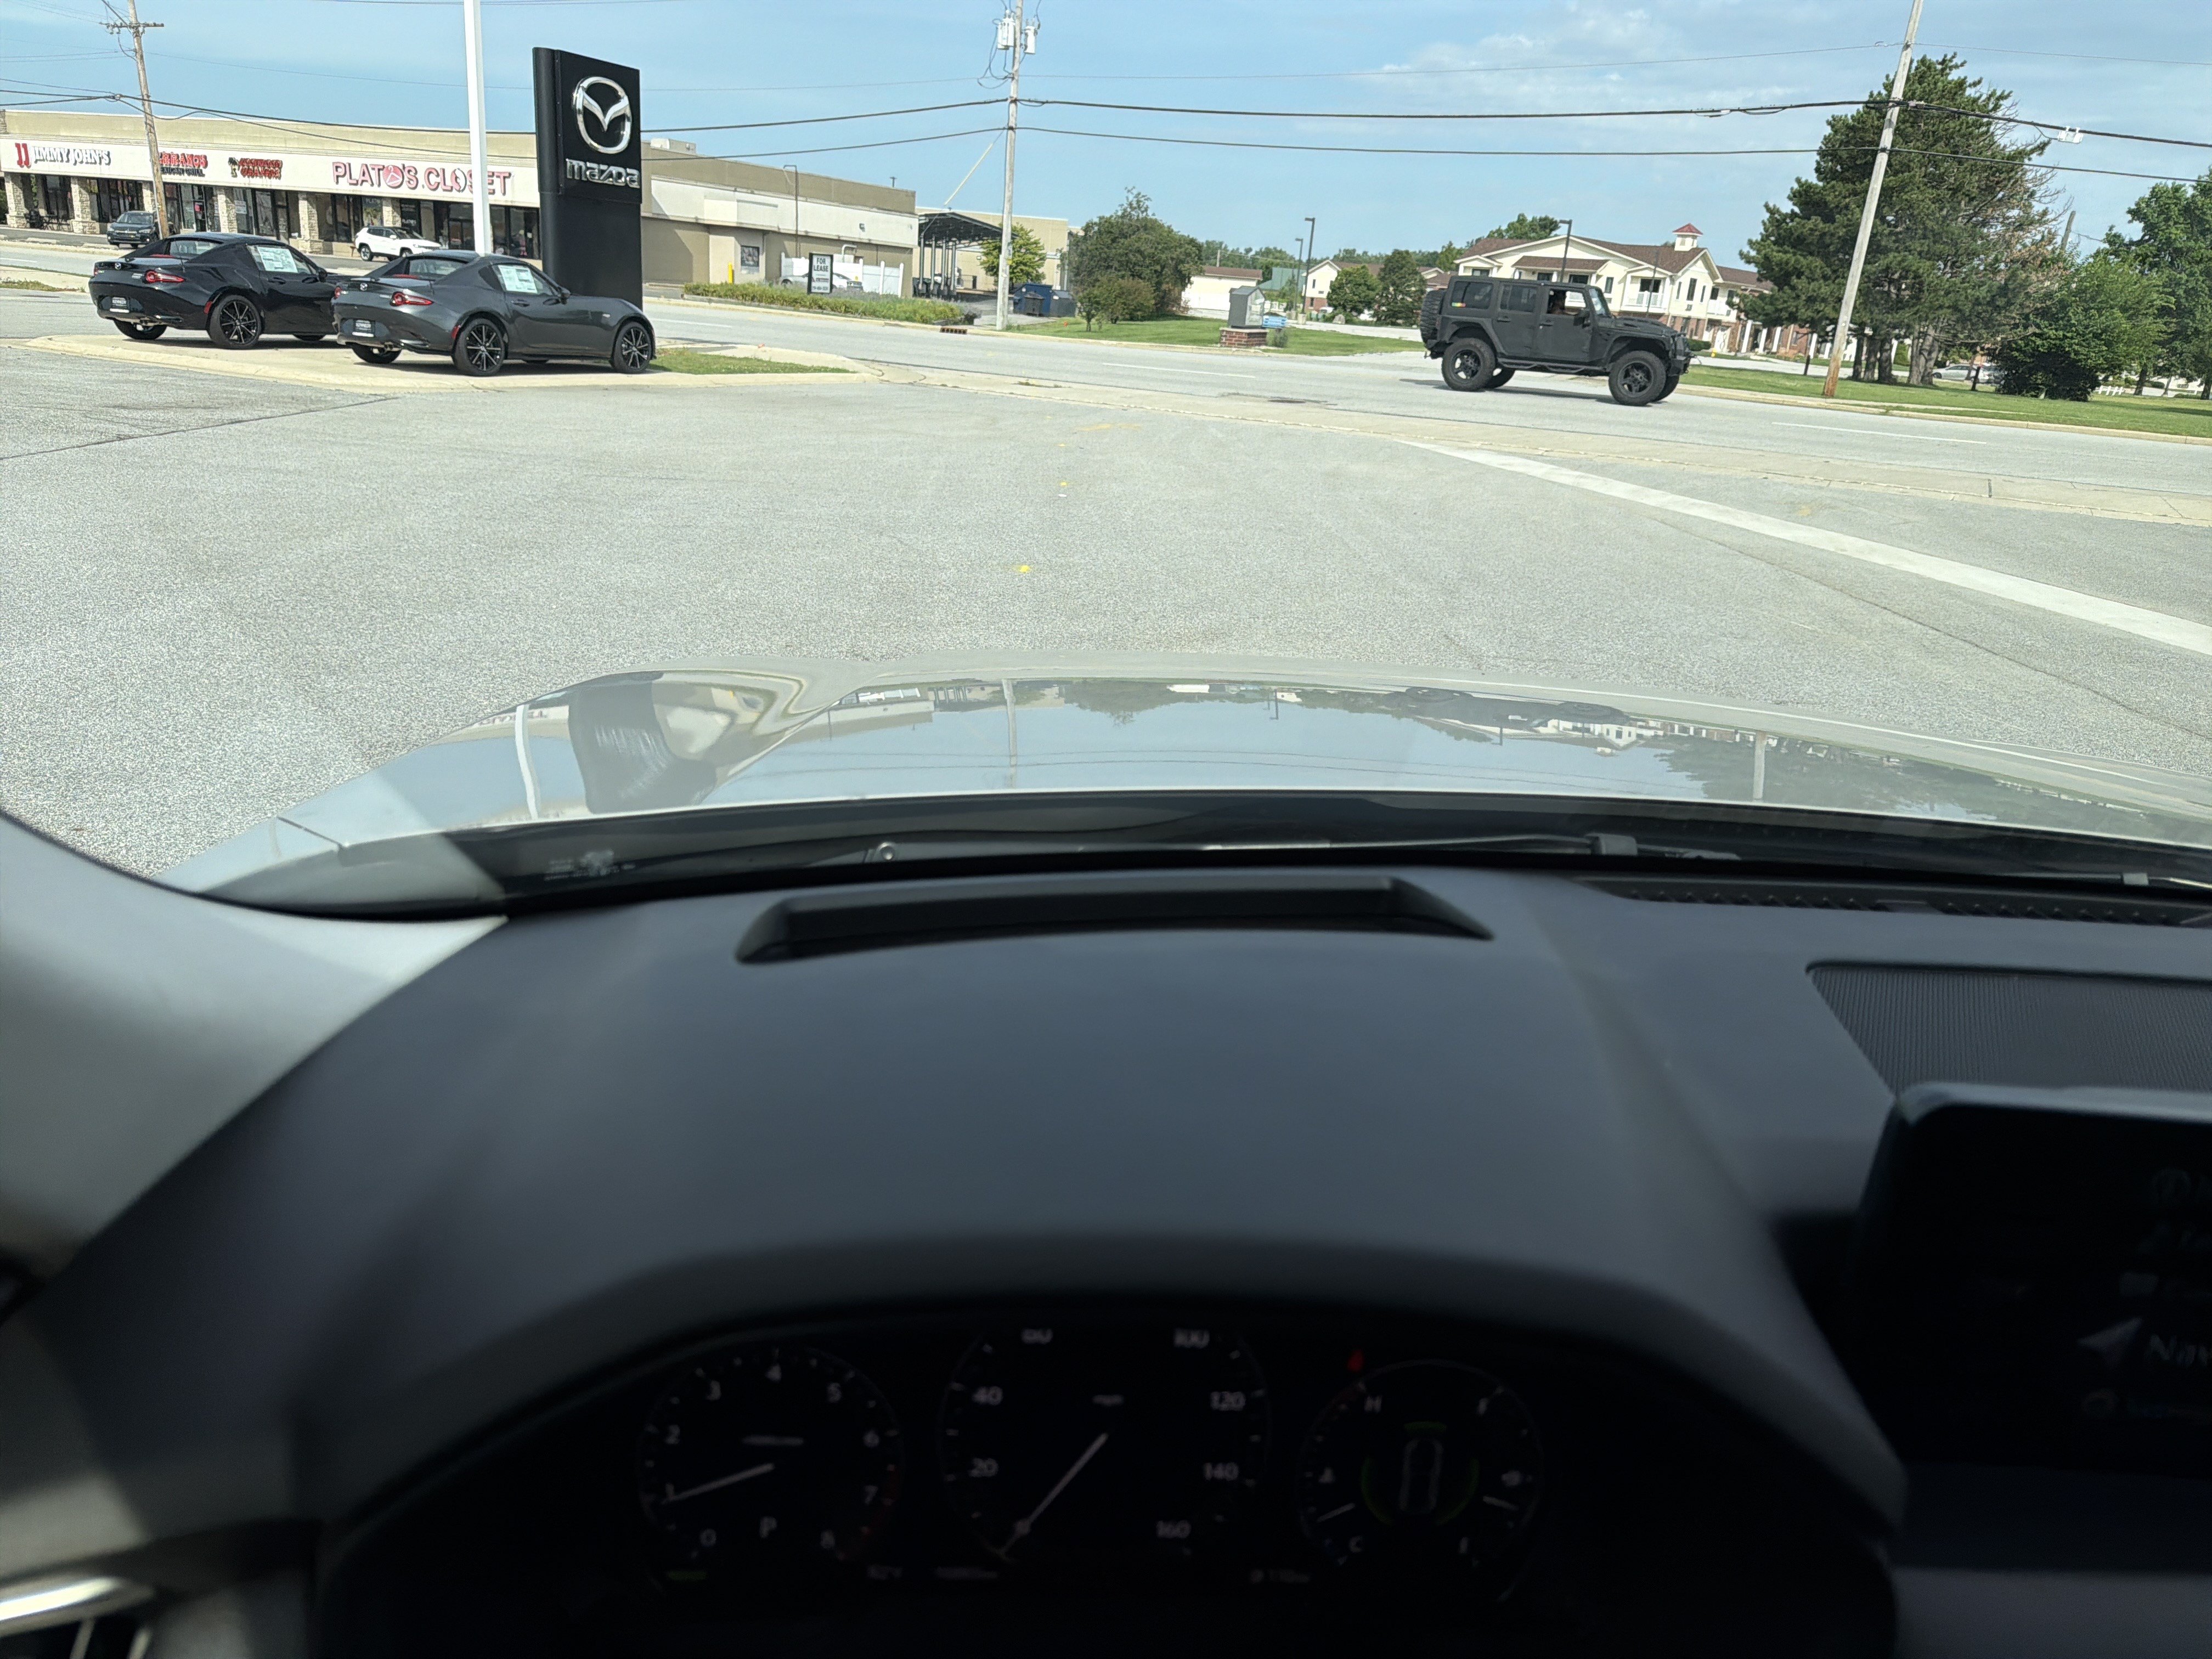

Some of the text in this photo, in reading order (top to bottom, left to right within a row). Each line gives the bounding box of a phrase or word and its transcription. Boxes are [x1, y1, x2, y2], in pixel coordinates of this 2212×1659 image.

[32, 146, 111, 166] JIMMY JOHN'S
[160, 166, 185, 176] EXICAN
[332, 161, 419, 190] PLATO'S
[566, 158, 640, 189] mazda
[972, 1386, 1003, 1406] 40
[1210, 1391, 1246, 1411] 120
[968, 1457, 998, 1478] 20
[1203, 1462, 1239, 1481] 140
[1156, 1520, 1191, 1539] 160
